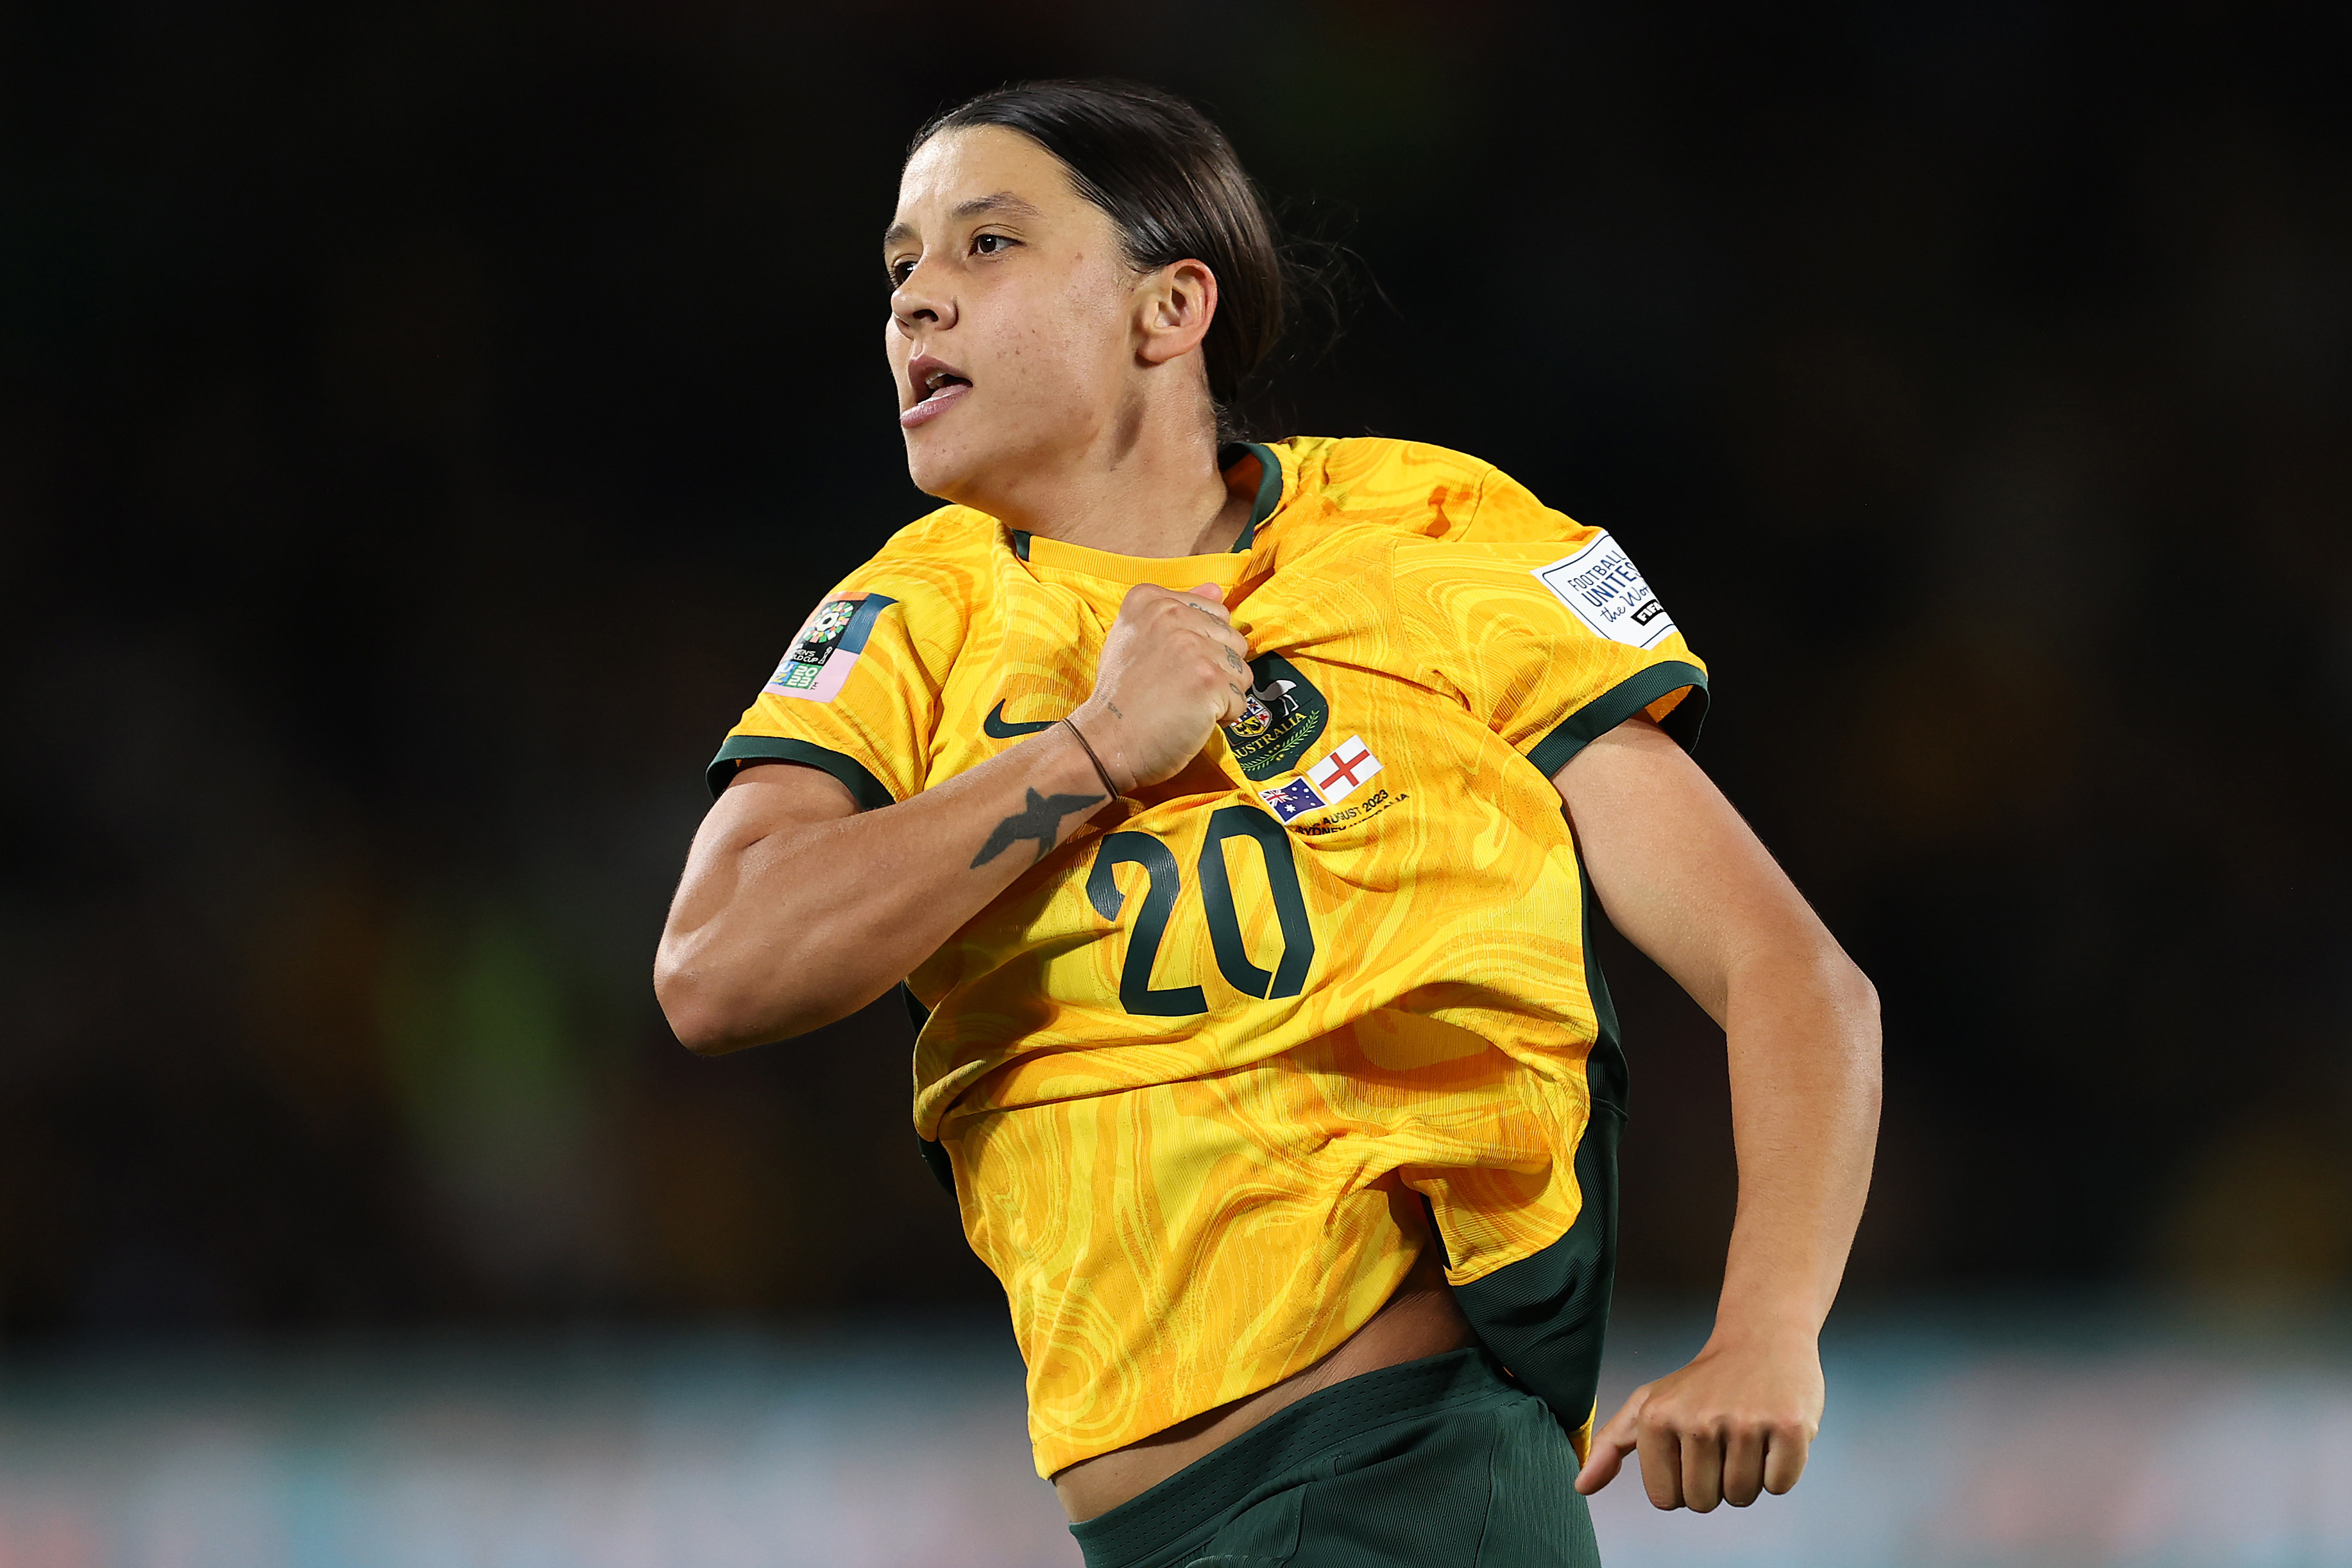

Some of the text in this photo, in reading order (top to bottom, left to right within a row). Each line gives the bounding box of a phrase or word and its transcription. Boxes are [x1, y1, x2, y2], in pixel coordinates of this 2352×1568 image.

[1567, 550, 1626, 592] FOOTBALL
[1581, 561, 1642, 607] UNITES
[1599, 586, 1649, 622] the Wor
[1637, 601, 1664, 622] FIFA
[787, 675, 812, 687] 23
[794, 665, 819, 677] 20
[1323, 806, 1362, 825] AUGUST
[1362, 789, 1389, 813] 2023
[1086, 805, 1315, 1017] 20
